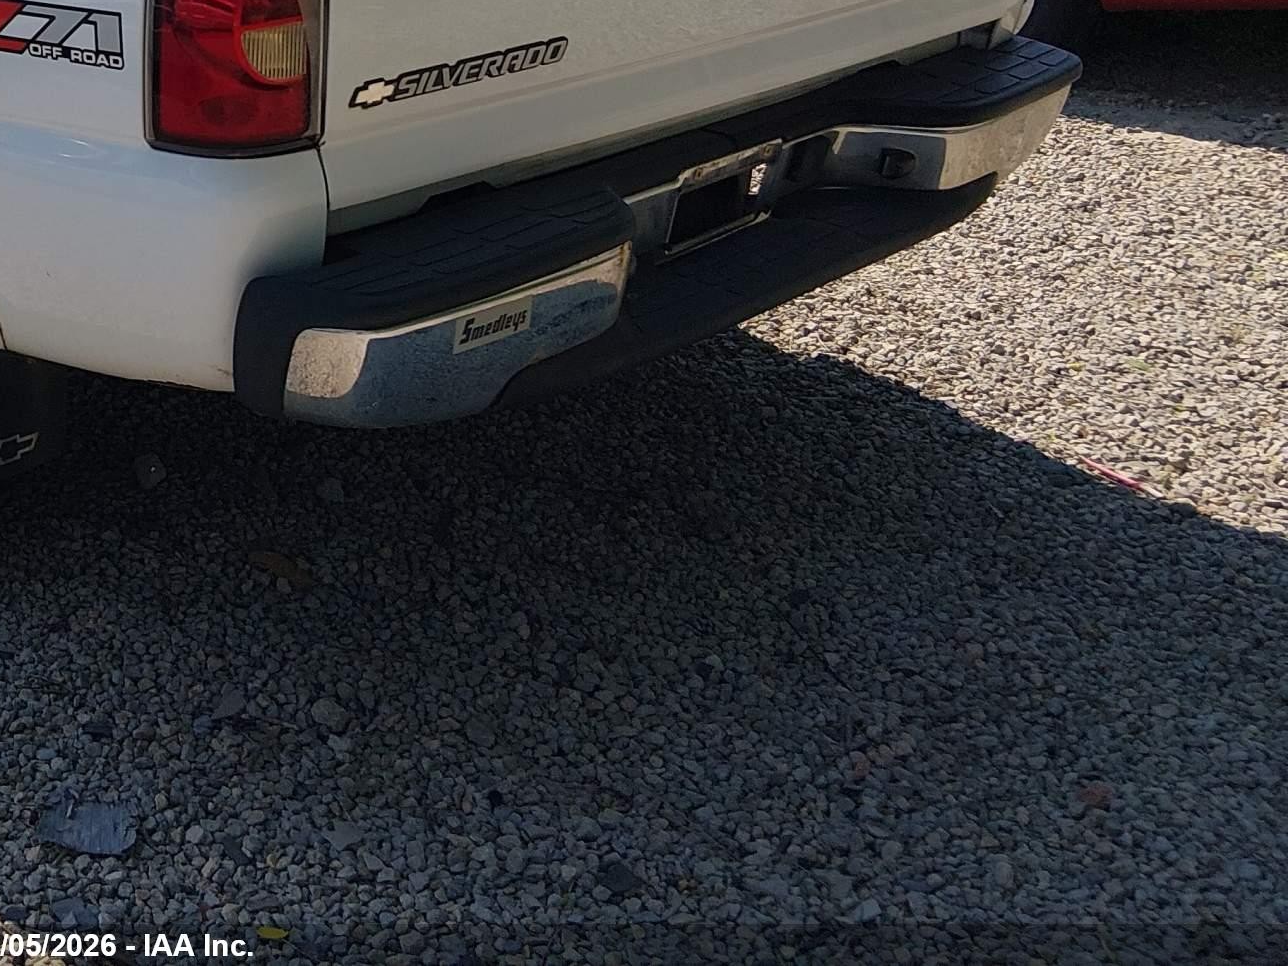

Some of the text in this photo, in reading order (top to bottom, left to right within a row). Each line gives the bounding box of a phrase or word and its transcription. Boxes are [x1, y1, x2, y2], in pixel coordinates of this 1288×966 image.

[27, 42, 124, 70] OFF ROAD
[389, 36, 569, 102] SILVERADO
[458, 310, 528, 345] Smedleys
